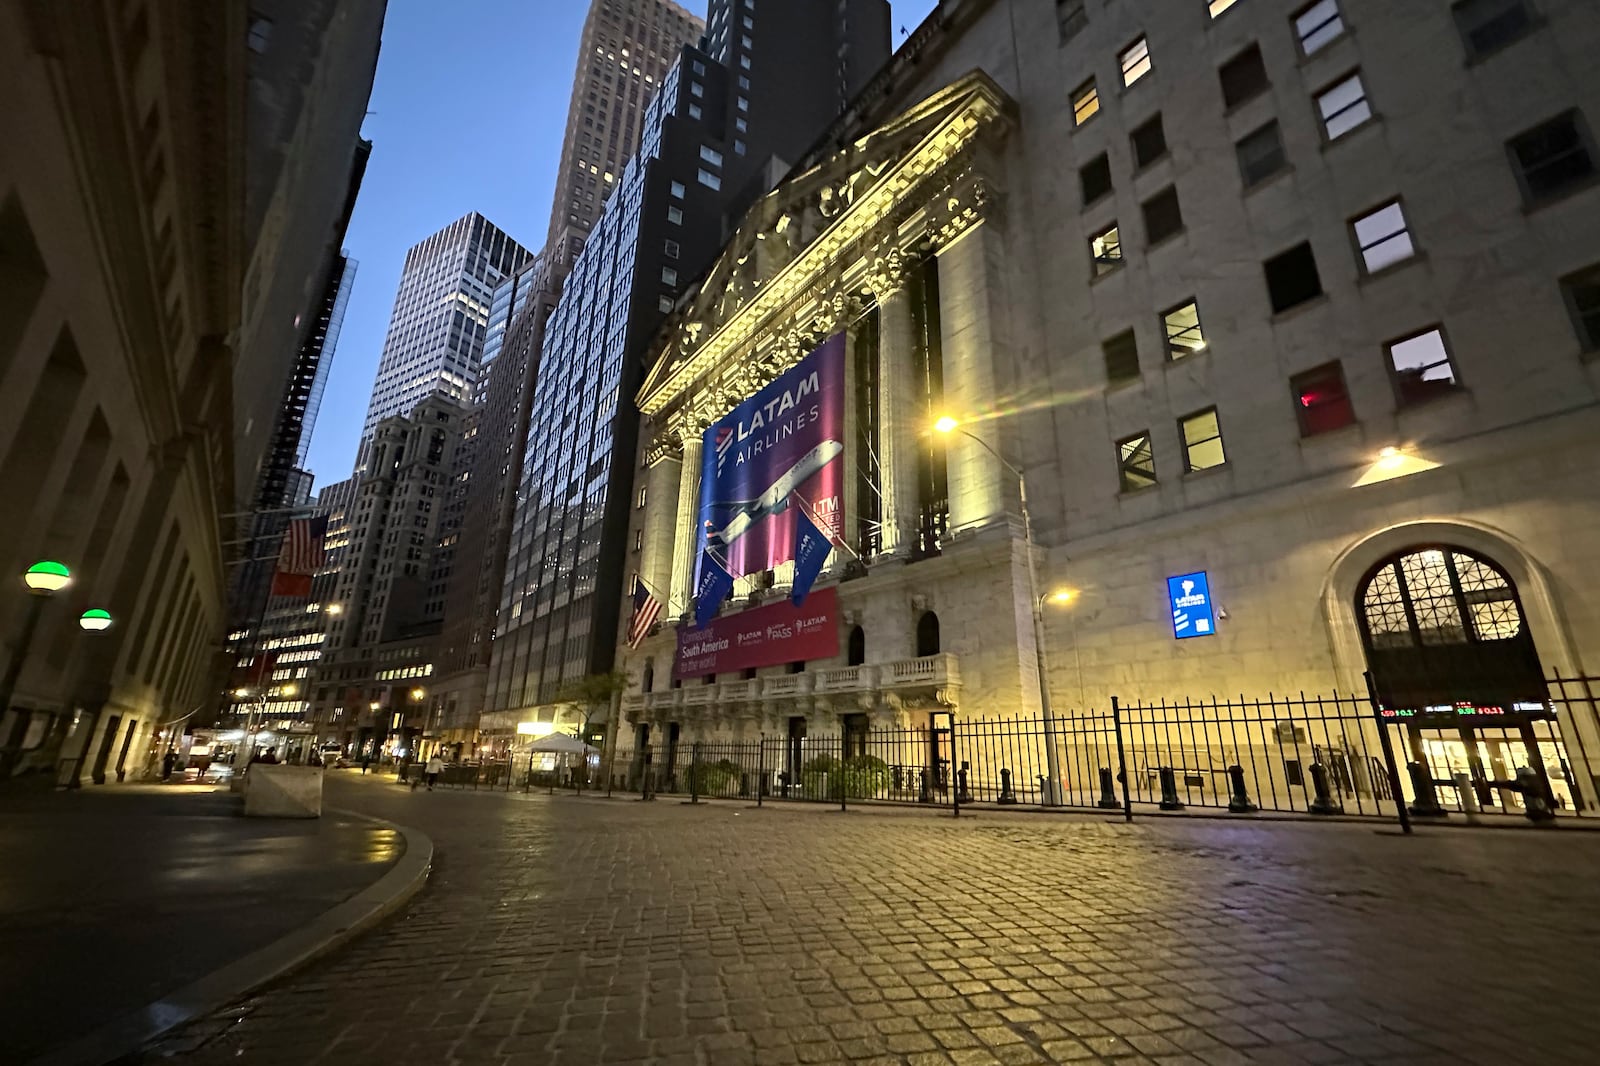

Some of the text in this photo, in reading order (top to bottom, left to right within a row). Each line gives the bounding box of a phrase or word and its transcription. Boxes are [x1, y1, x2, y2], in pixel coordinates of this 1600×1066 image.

[738, 371, 819, 442] LATAM
[736, 405, 819, 467] AIRLINES
[813, 496, 839, 517] LTM
[772, 627, 792, 640] PASS
[682, 643, 700, 658] South
[701, 637, 729, 654] America
